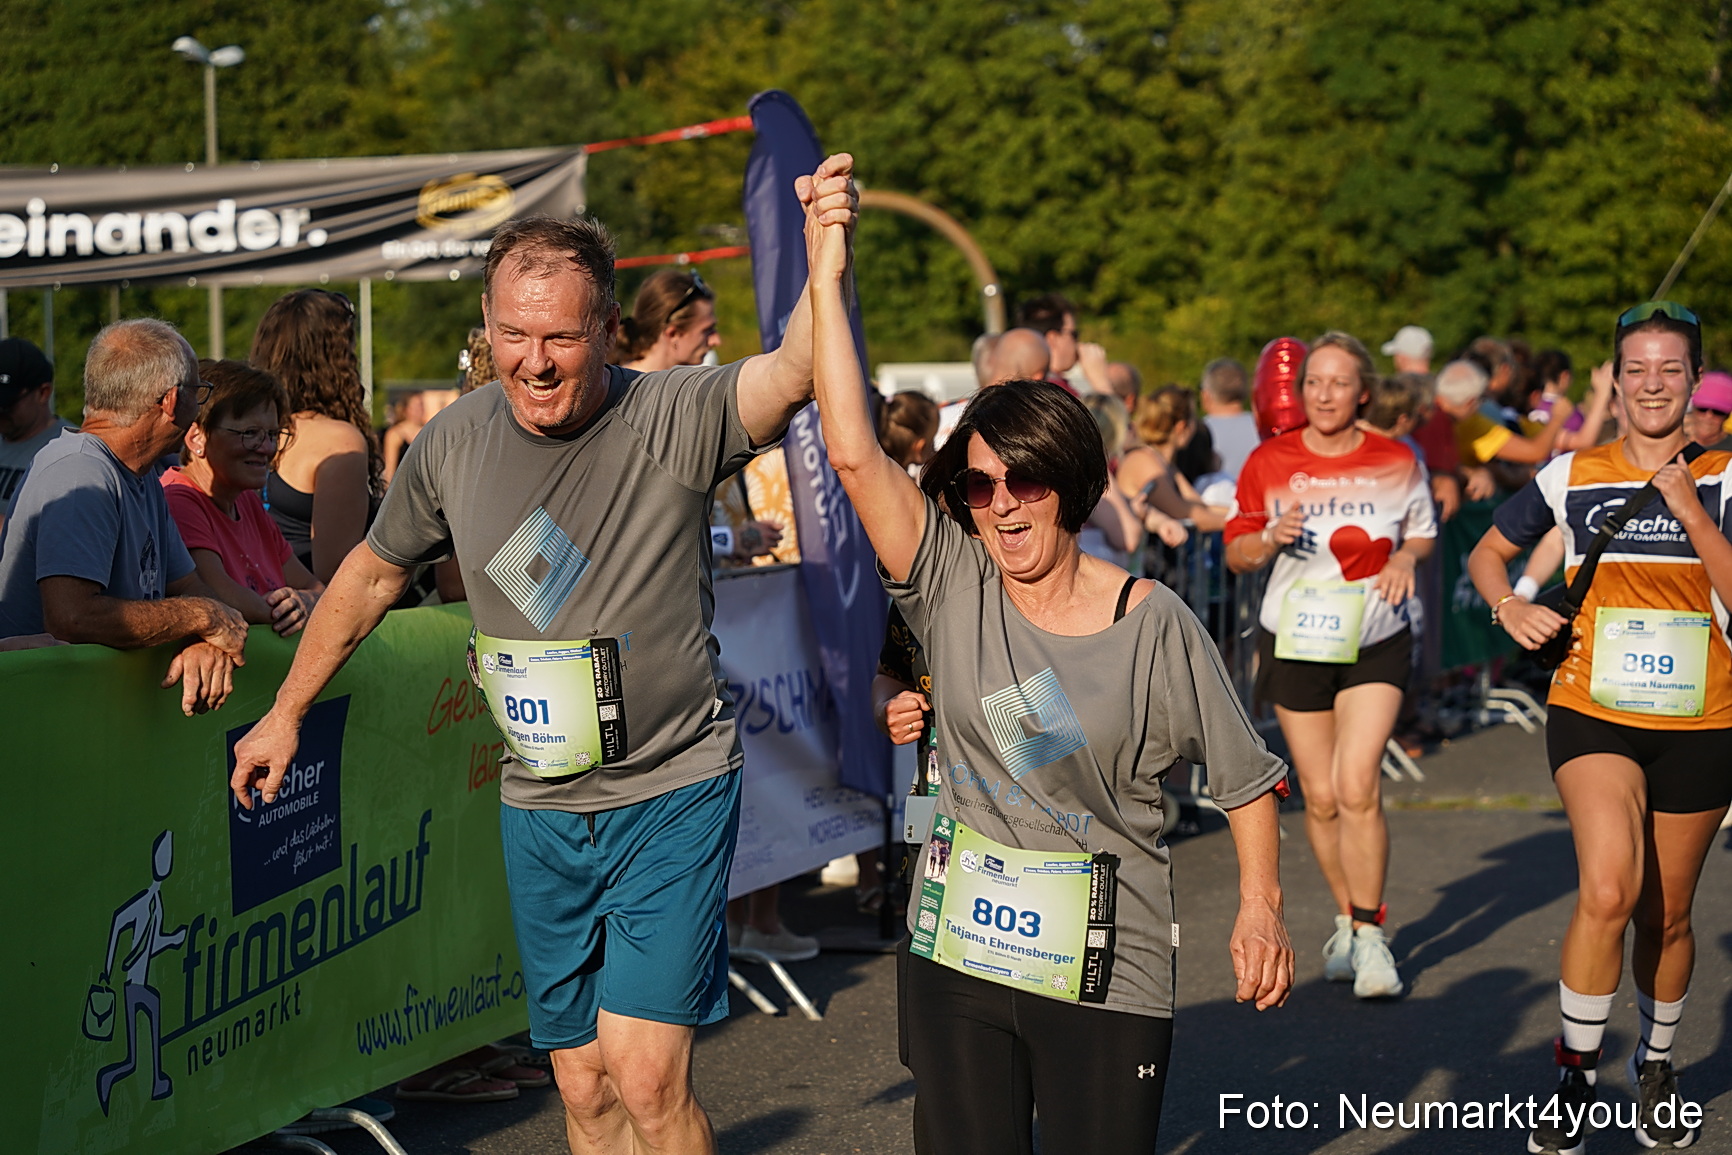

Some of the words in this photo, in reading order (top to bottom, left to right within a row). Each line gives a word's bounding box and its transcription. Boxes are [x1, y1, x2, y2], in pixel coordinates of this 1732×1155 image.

[0, 198, 328, 258] einander.
[1275, 497, 1375, 518] Lufen
[1612, 514, 1683, 533] sche
[1297, 612, 1341, 631] 2173
[592, 647, 602, 680] RABATT
[597, 687, 604, 698] 20
[1649, 680, 1696, 691] Naumann
[505, 695, 550, 725] 801
[532, 733, 566, 743] Böhm
[605, 723, 616, 758] HILTL
[250, 760, 325, 811] Fcher
[1005, 785, 1026, 807] &
[258, 790, 320, 828] AUTOMOBILE
[935, 825, 953, 838] AOK
[977, 865, 1020, 883] Firmenlauf
[1091, 863, 1099, 899] RABATT
[182, 808, 432, 1029] firmenlauf
[972, 897, 1041, 939] 803
[1090, 908, 1097, 921] 20
[945, 918, 986, 945] Tatjana
[989, 937, 1075, 965] Ehrensberger
[1085, 951, 1100, 993] HILTL
[356, 953, 528, 1056] www.firmenlauf-o
[187, 981, 302, 1076] neumarkt
